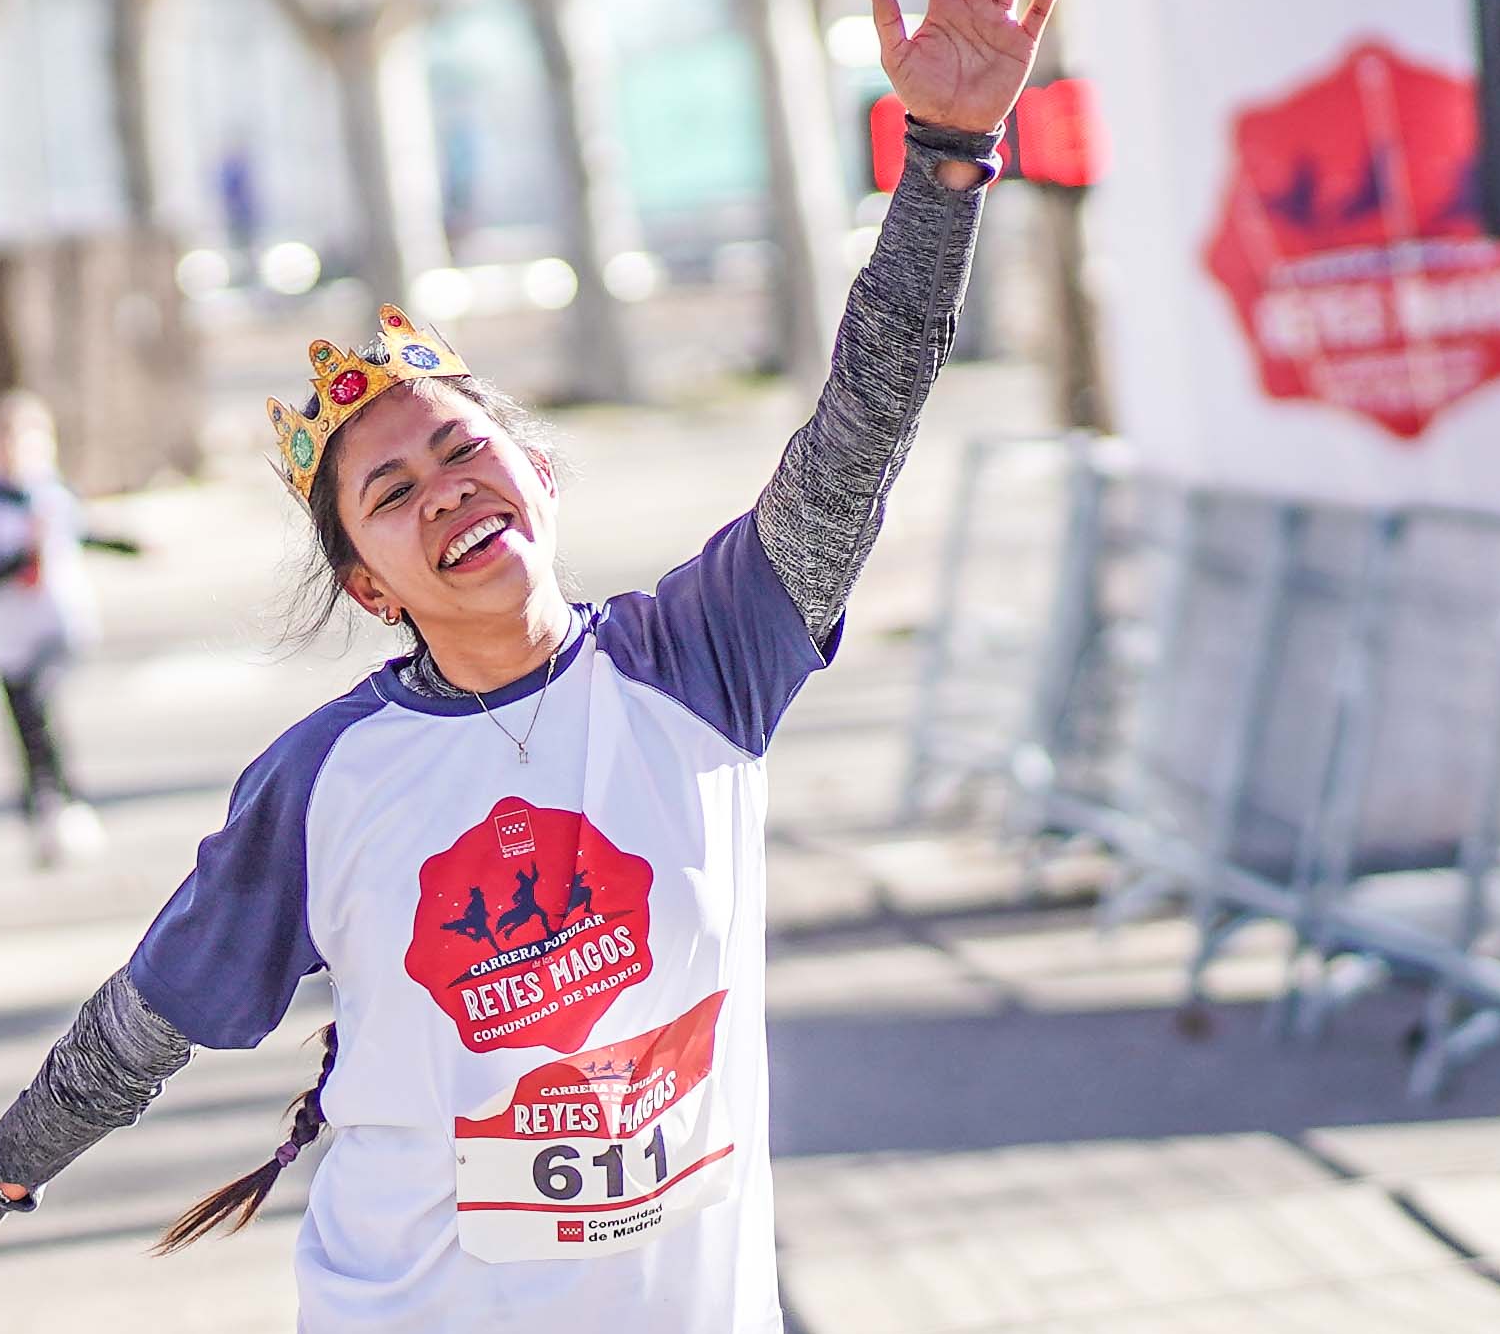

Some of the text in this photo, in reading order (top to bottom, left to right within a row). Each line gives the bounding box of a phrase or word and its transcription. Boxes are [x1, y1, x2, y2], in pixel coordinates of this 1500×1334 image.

[461, 925, 636, 1021] REYES MAGOS
[470, 914, 605, 976] CARRERA POPULAR
[473, 962, 642, 1043] COMUNIDAD DE MADRID
[513, 1069, 676, 1135] REYES MAGOS
[540, 1084, 608, 1096] CARRERA
[532, 1124, 668, 1200] 611
[588, 1203, 663, 1229] Comunidad
[588, 1215, 662, 1242] de Madrid
